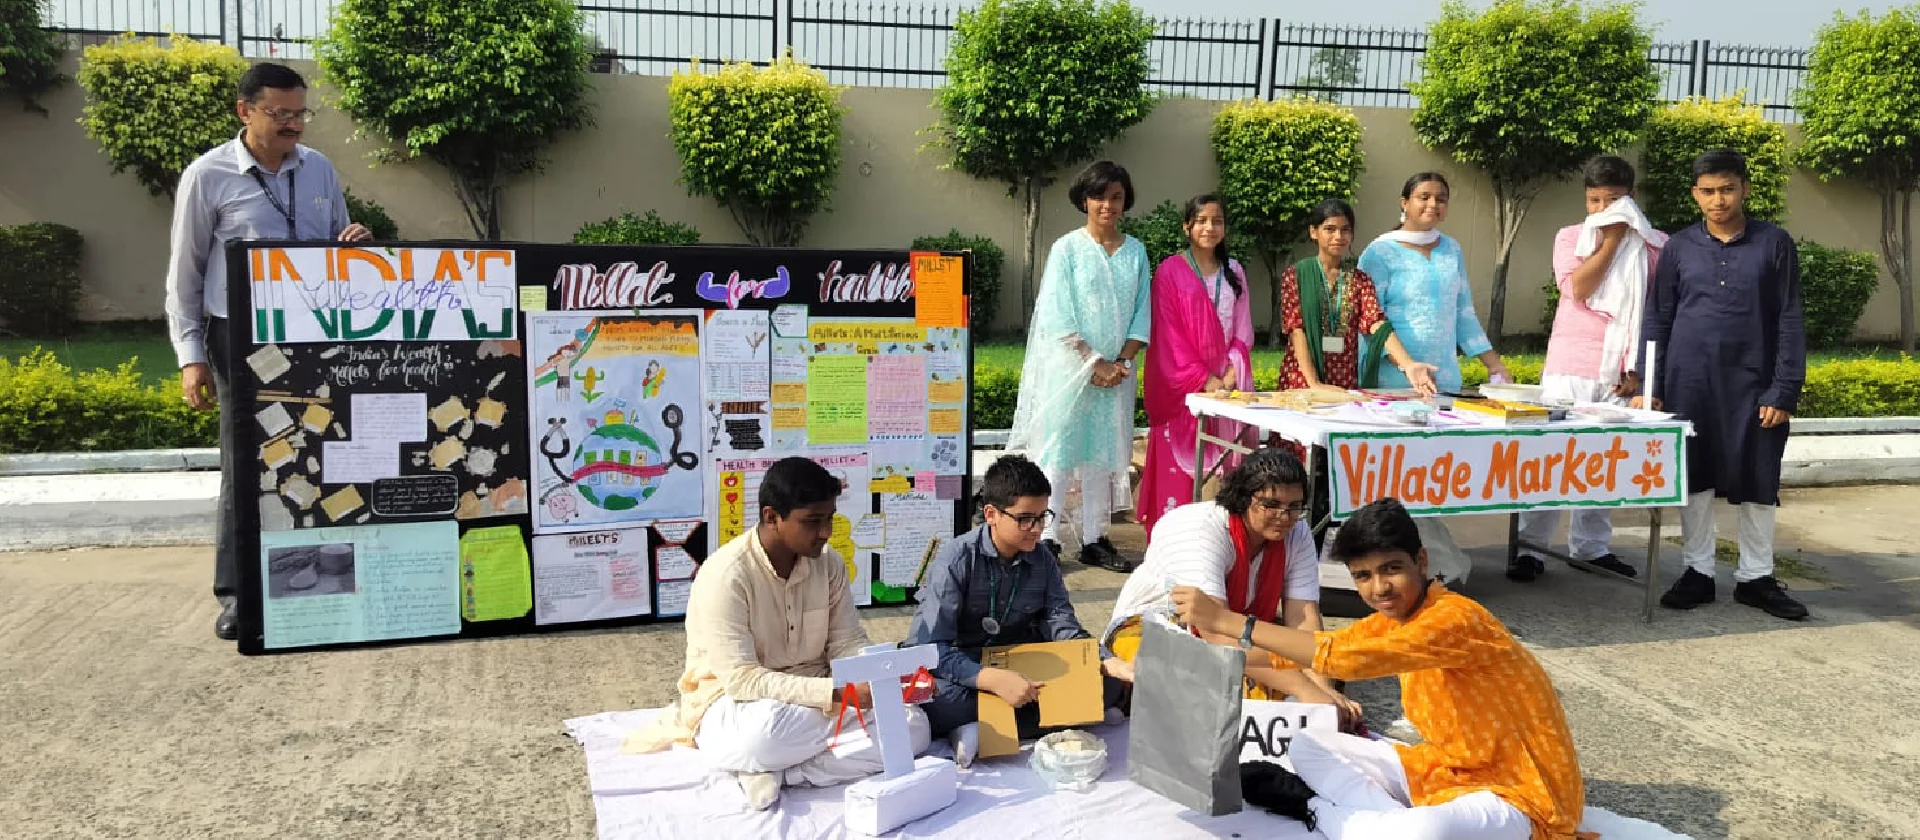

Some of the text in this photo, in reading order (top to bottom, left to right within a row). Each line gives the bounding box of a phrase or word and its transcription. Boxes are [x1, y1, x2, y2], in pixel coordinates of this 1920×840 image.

[251, 248, 511, 341] INDIA'S
[303, 280, 462, 312] Wealth
[727, 270, 767, 309] for
[1339, 435, 1629, 507] Village Market
